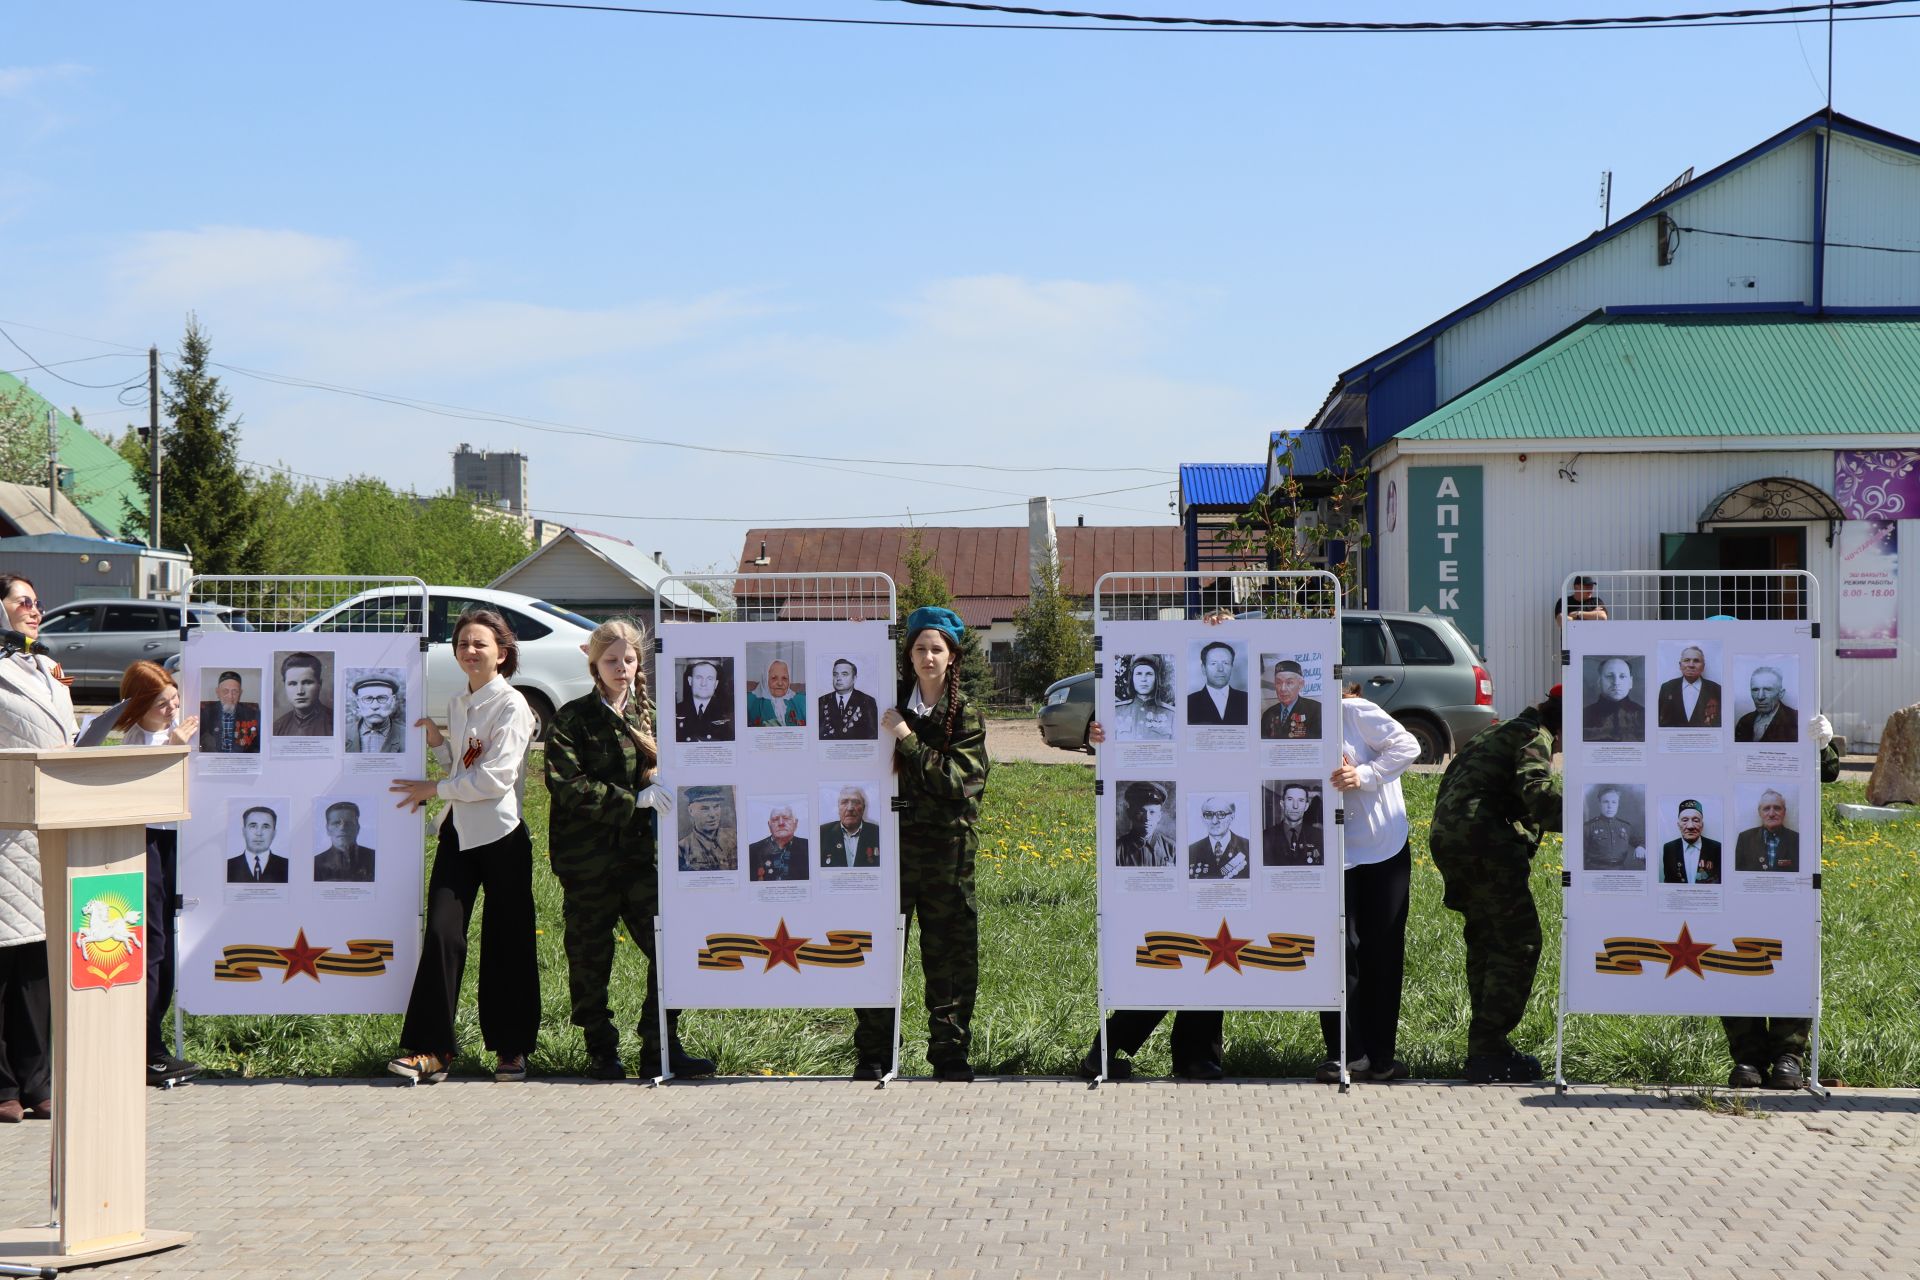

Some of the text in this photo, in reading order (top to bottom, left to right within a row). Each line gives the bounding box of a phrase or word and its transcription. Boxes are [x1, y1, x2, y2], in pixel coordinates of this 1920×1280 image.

[1436, 476, 1460, 625] АПТЕК
[1843, 589, 1862, 598] 8.00
[1871, 588, 1895, 598] 18.00
